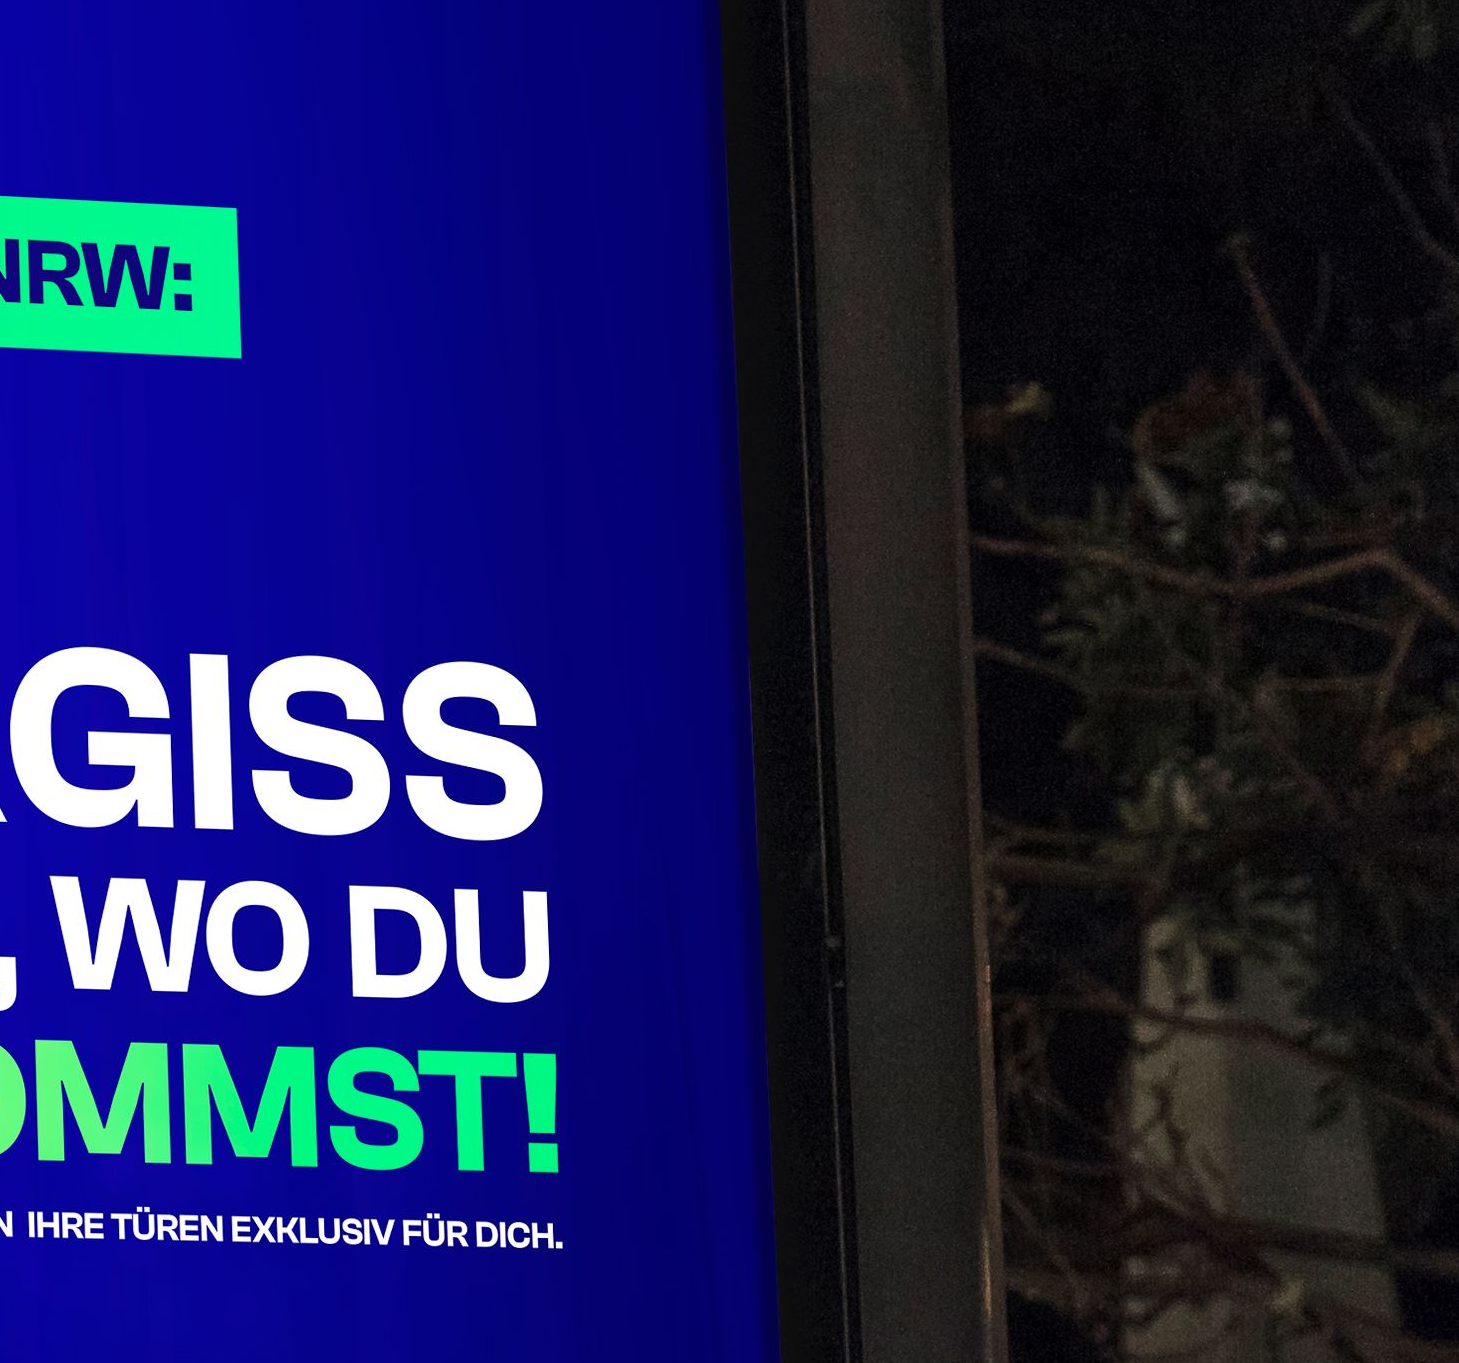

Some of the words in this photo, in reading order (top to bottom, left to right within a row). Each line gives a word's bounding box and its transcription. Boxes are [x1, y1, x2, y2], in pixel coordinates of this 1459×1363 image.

[49, 875, 310, 997] WO
[348, 885, 550, 1004] DU
[27, 1211, 105, 1240] IHRE
[110, 1206, 224, 1242] TÜREN
[231, 1215, 396, 1246] EXKLUSIV
[402, 1212, 469, 1248] FÜR
[475, 1221, 564, 1250] DICH.
